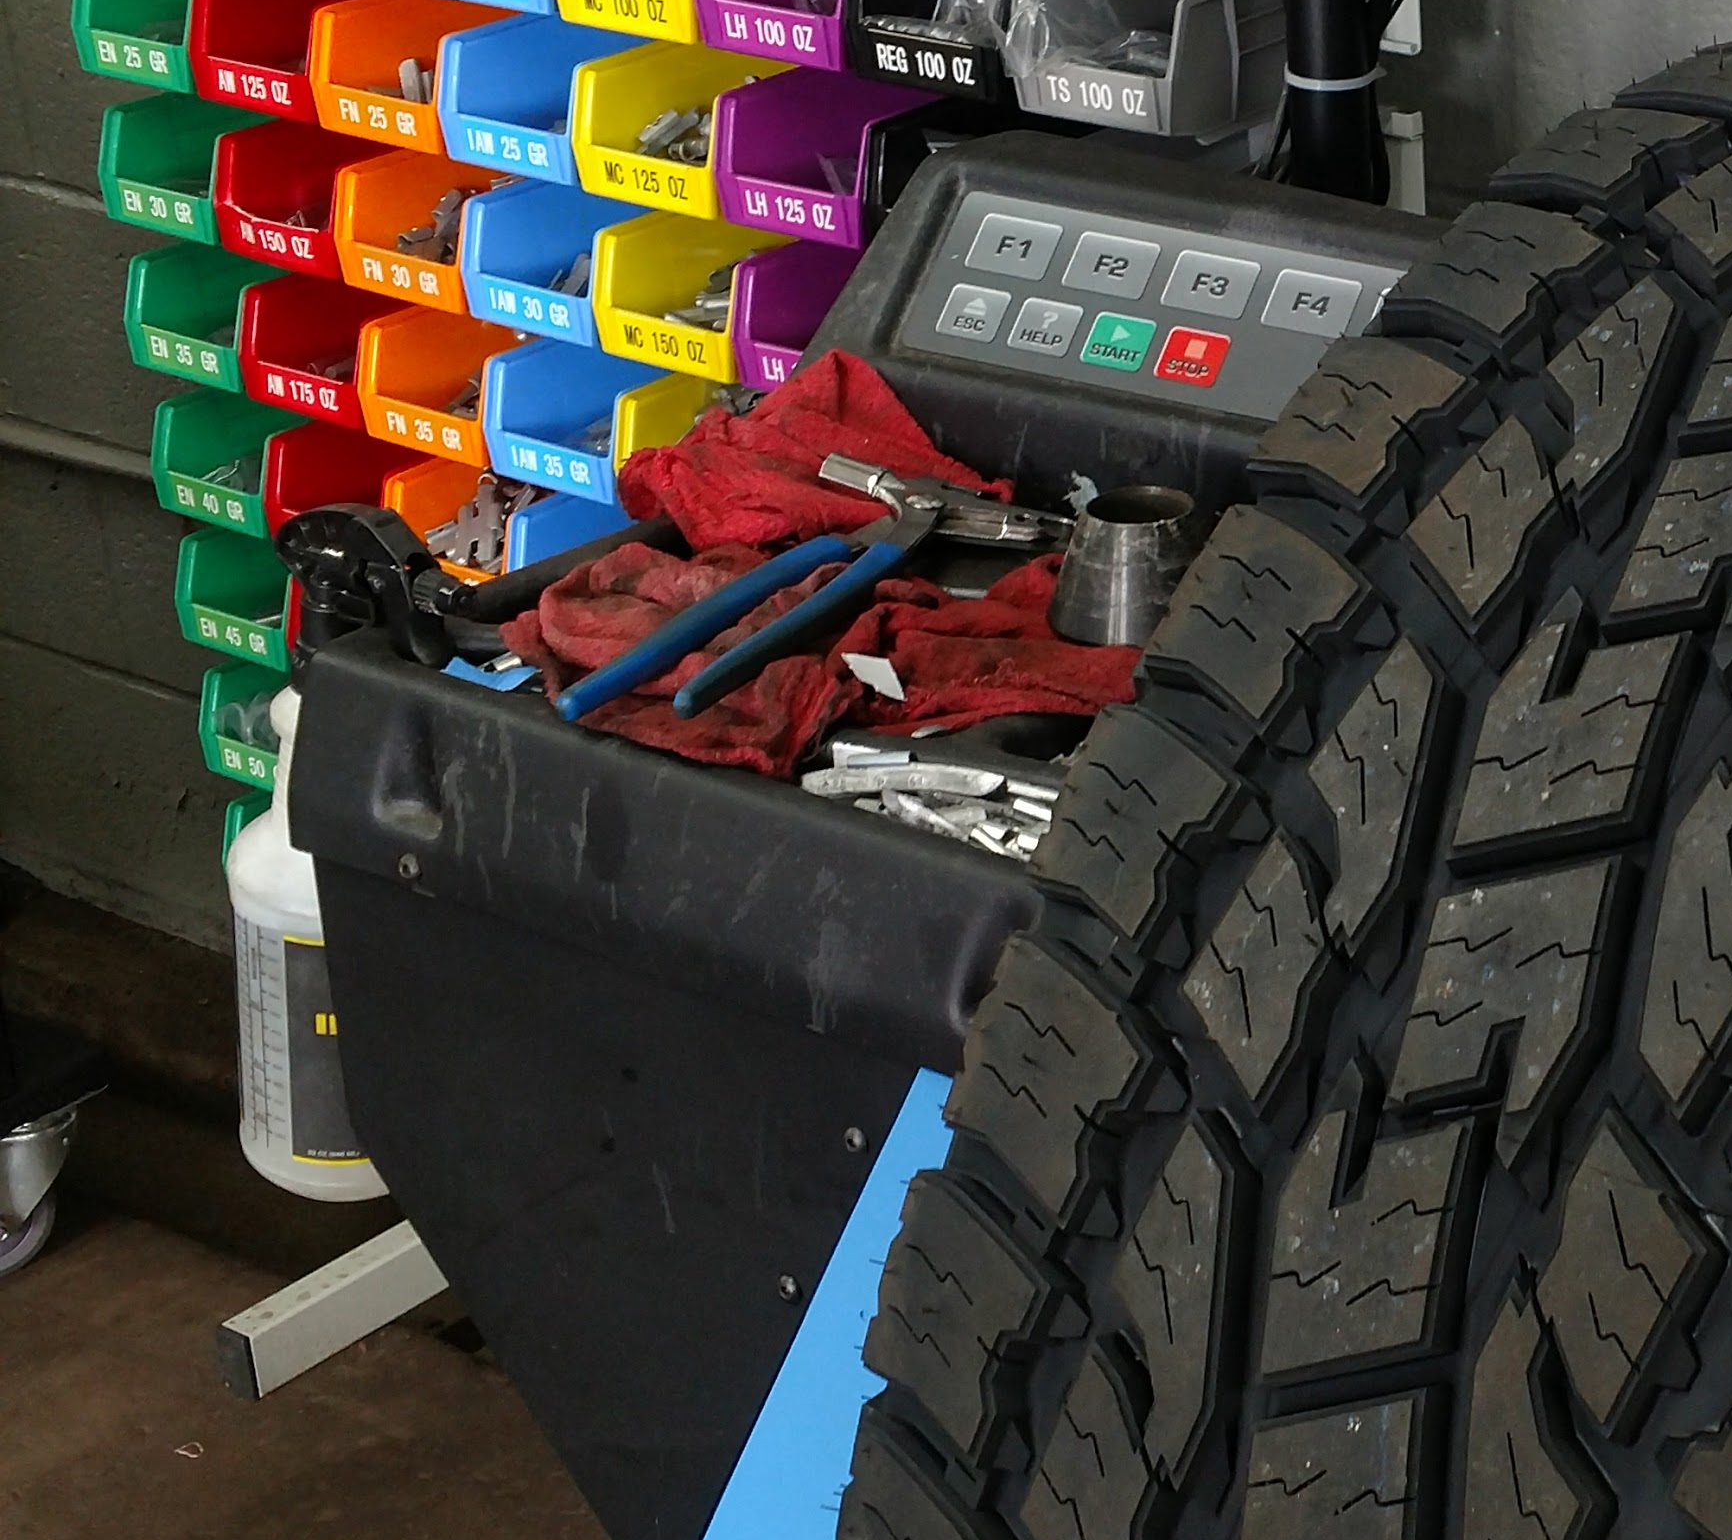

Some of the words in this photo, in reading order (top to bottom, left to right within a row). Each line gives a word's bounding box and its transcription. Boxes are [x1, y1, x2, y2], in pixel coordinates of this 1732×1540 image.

[724, 11, 747, 40] LH
[754, 18, 786, 47] 100
[792, 25, 816, 53] OZ
[876, 42, 908, 74] REG
[915, 49, 945, 81] 100
[953, 56, 976, 86] OZ
[1046, 76, 1071, 102] TS
[1079, 79, 1113, 111] 100
[1122, 87, 1147, 117] OZ
[339, 98, 360, 123] FN
[367, 104, 387, 129] 25
[396, 110, 416, 137] GR
[500, 136, 521, 161] 25
[527, 141, 549, 167] GR
[604, 160, 624, 186] MC
[632, 168, 660, 194] 125
[668, 175, 688, 200] OZ
[744, 190, 768, 217] LH
[775, 196, 805, 224] 125
[812, 203, 835, 230] OZ
[995, 235, 1033, 259] F1
[363, 257, 383, 282] FN
[392, 264, 411, 288] 30
[419, 271, 439, 296] GR
[1093, 254, 1129, 278] F2
[1191, 273, 1229, 297] F3
[523, 295, 542, 321] 30
[549, 302, 570, 328] GR
[1292, 292, 1330, 316] F4
[953, 315, 985, 331] ESC
[1019, 328, 1063, 348] HELP
[624, 325, 643, 349] MC
[652, 332, 678, 357] 150
[687, 340, 706, 364] OZ
[1089, 344, 1140, 364] START
[1165, 359, 1209, 378] STOP
[386, 411, 406, 435] FN
[414, 418, 433, 442] 35
[442, 427, 463, 451] GR
[544, 454, 563, 478] 35
[570, 460, 591, 485] GR
[176, 485, 194, 508] EN
[203, 493, 218, 514] 40
[226, 499, 245, 523] GR
[200, 617, 218, 640] EN
[225, 624, 243, 648] 45
[249, 632, 267, 656] GR
